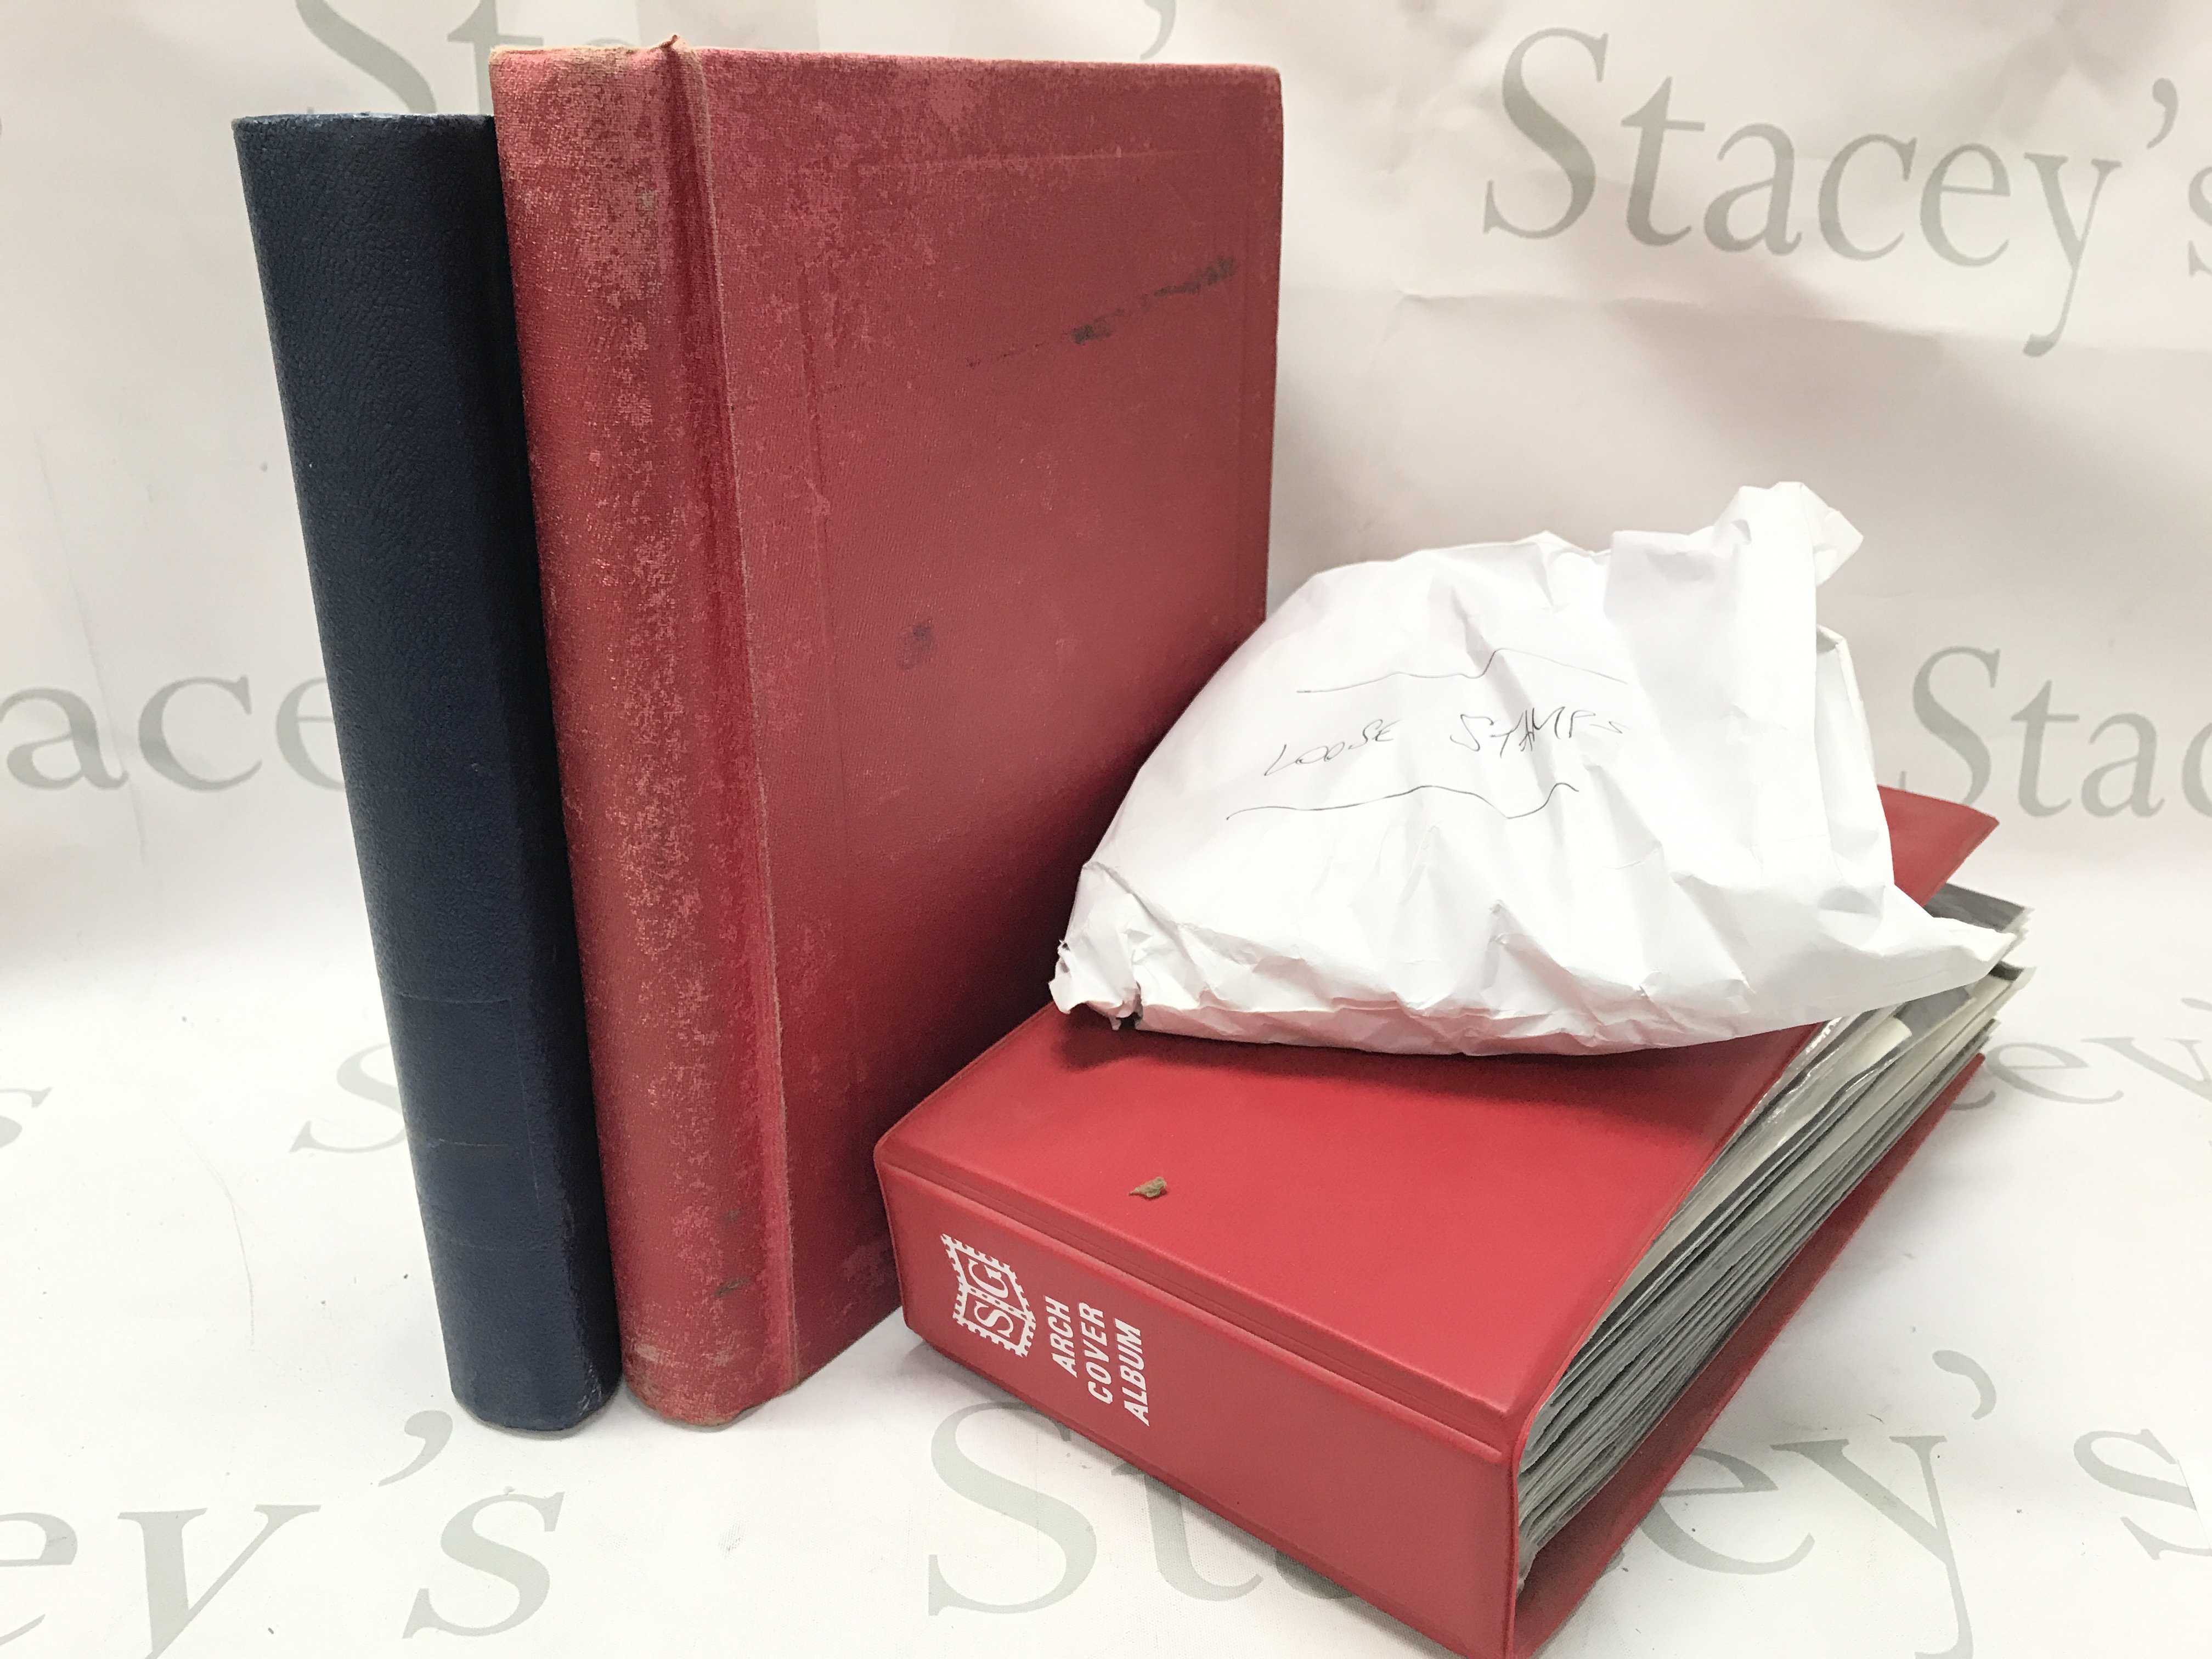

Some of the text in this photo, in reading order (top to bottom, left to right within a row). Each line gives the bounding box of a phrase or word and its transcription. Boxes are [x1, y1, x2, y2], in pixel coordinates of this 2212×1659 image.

[1263, 706, 1631, 777] LOOSE STAMPS
[1043, 1294, 1078, 1378] ARCH
[1077, 1301, 1114, 1404] COVER
[1114, 1317, 1150, 1427] ALBUM
